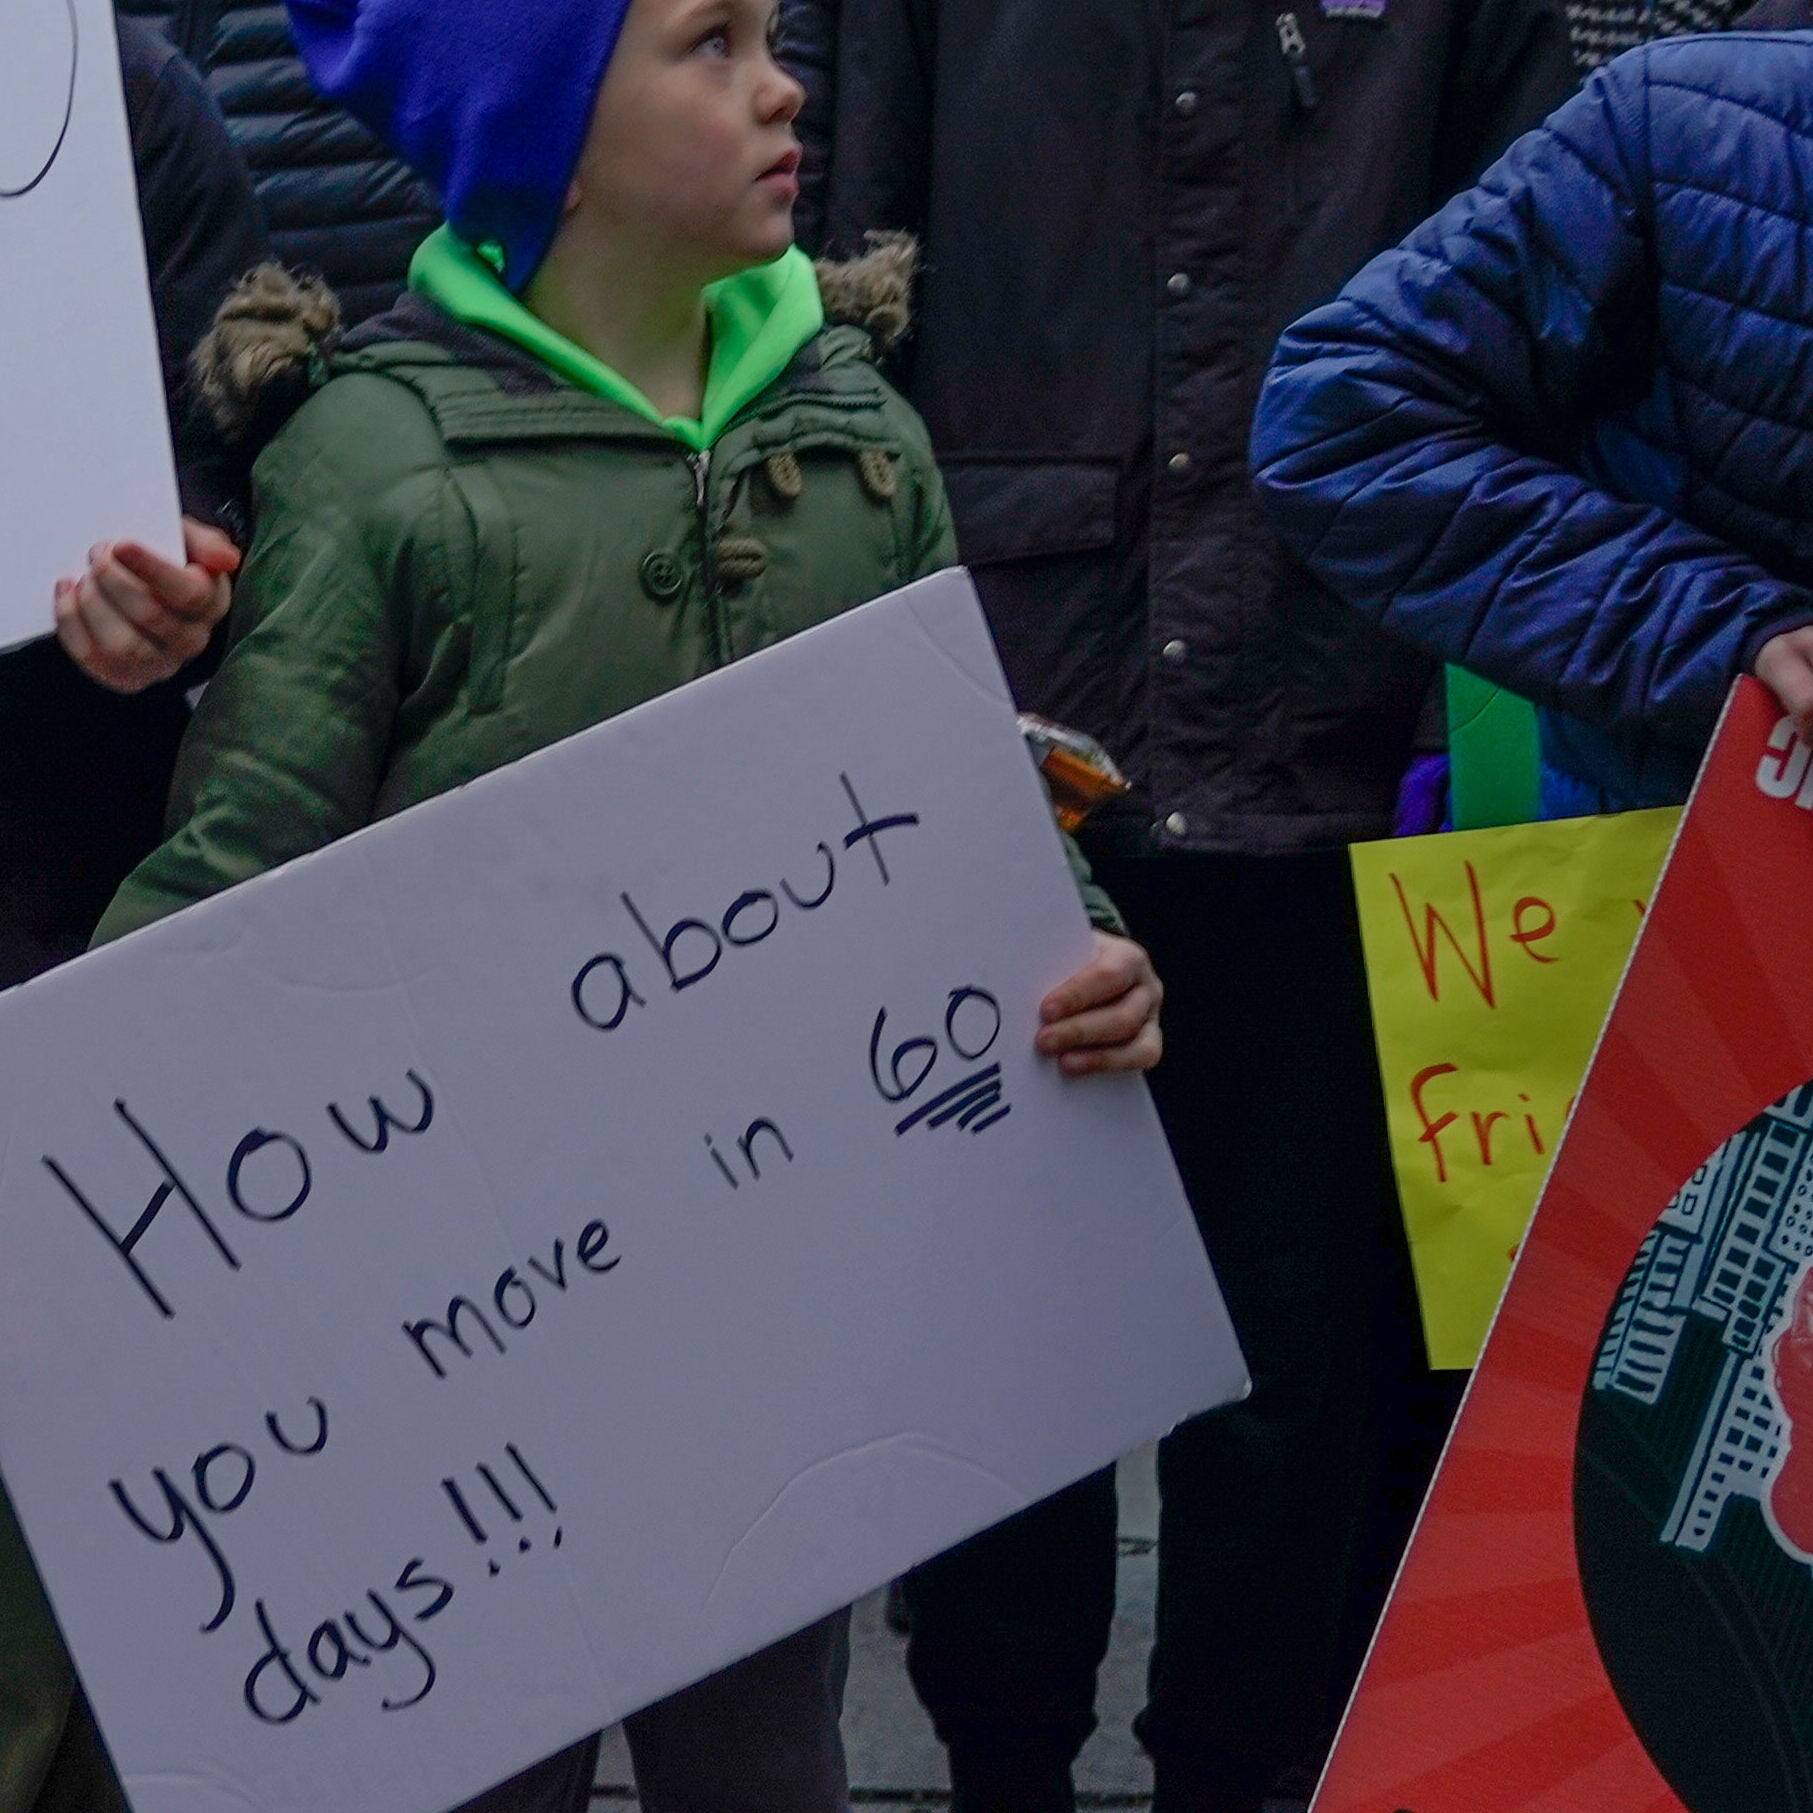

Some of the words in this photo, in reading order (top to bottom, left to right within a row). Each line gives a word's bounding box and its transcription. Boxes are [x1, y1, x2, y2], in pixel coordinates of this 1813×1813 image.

[41, 1069, 435, 1319] How
[571, 774, 921, 1032] about
[1389, 860, 1560, 1010] We
[108, 1396, 329, 1634] you
[401, 1218, 623, 1379] move
[704, 1117, 794, 1189] in
[869, 984, 1003, 1105] 60
[242, 1442, 564, 1725] days!!!
